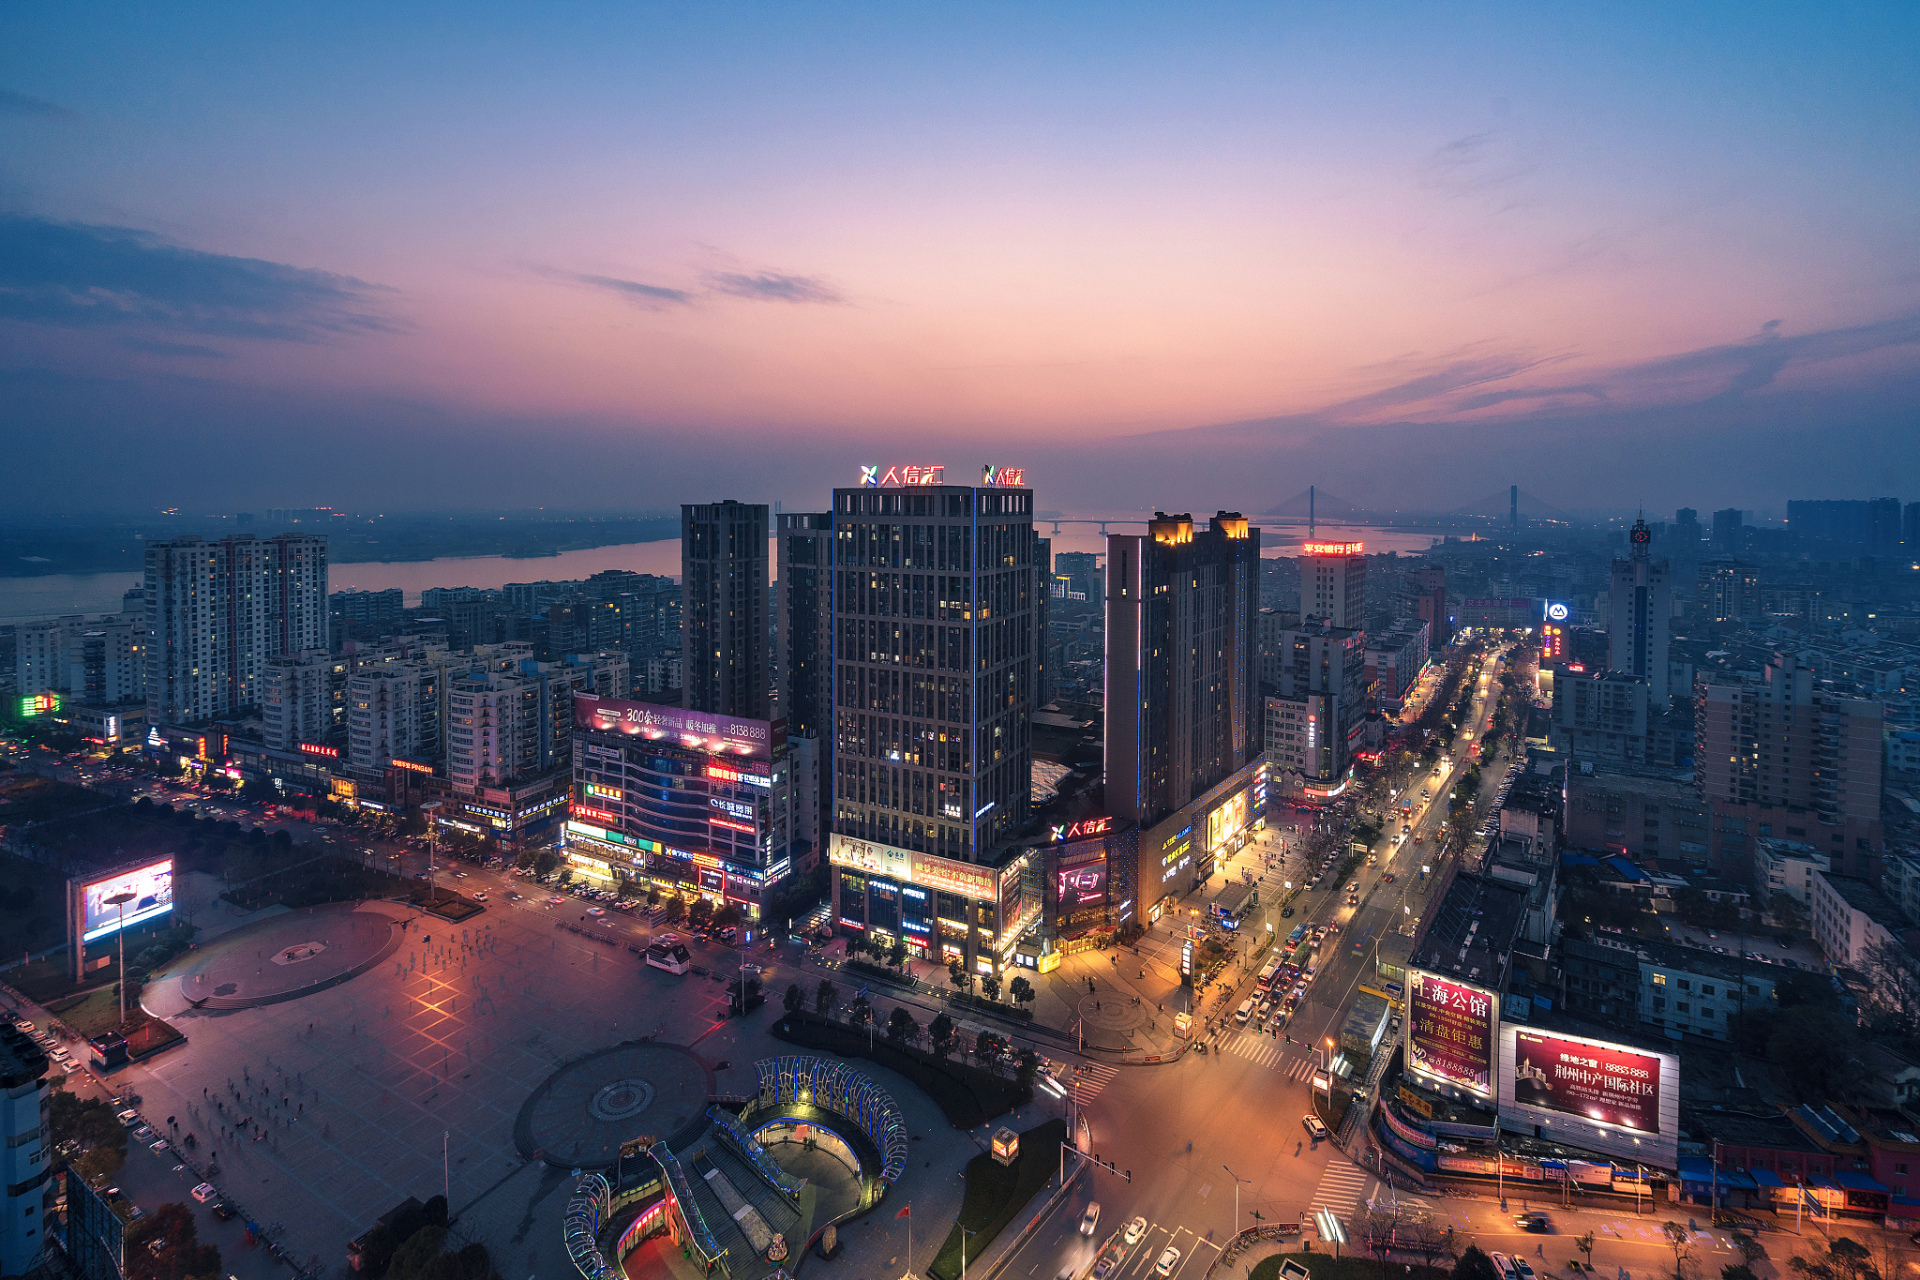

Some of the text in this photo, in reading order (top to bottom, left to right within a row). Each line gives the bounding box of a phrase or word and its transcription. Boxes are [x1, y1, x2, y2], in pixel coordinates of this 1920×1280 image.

[881, 465, 944, 485] 人信汇
[995, 467, 1025, 486] 人信汇
[1304, 544, 1344, 553] 平安银行
[730, 724, 748, 737] 8138
[1067, 816, 1112, 838] 人信汇
[1414, 981, 1488, 1017] 上海公馆
[1420, 1018, 1482, 1050] 清盘钜惠
[1435, 1057, 1475, 1077] 8188888
[1560, 1053, 1649, 1079] 绿地之窗 8883 888
[1554, 1063, 1654, 1096] 荆州中产国际社区
